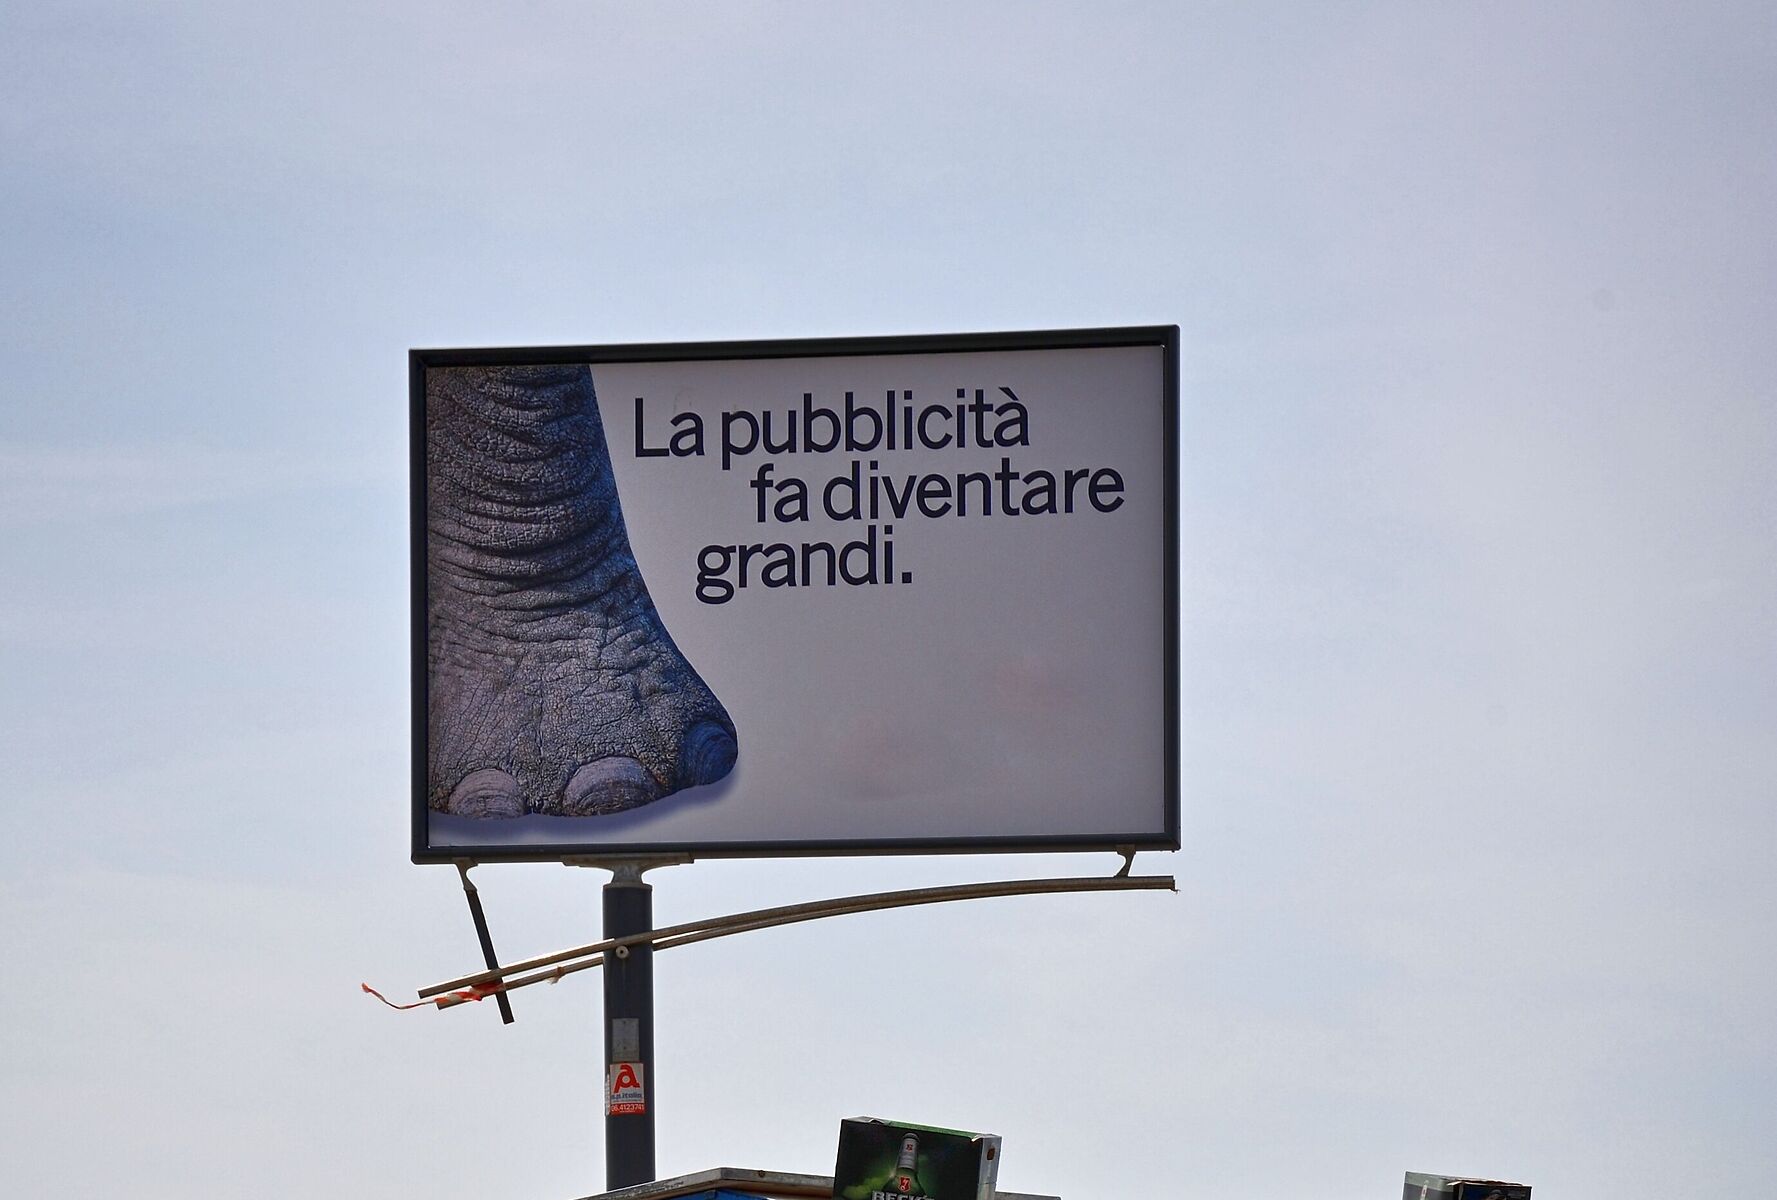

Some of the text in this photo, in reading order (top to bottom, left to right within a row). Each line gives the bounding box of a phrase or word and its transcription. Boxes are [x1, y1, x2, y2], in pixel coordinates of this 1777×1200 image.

[634, 387, 1030, 471] La pubblicità
[751, 458, 1125, 523] fa diventare
[695, 526, 913, 605] grandi.
